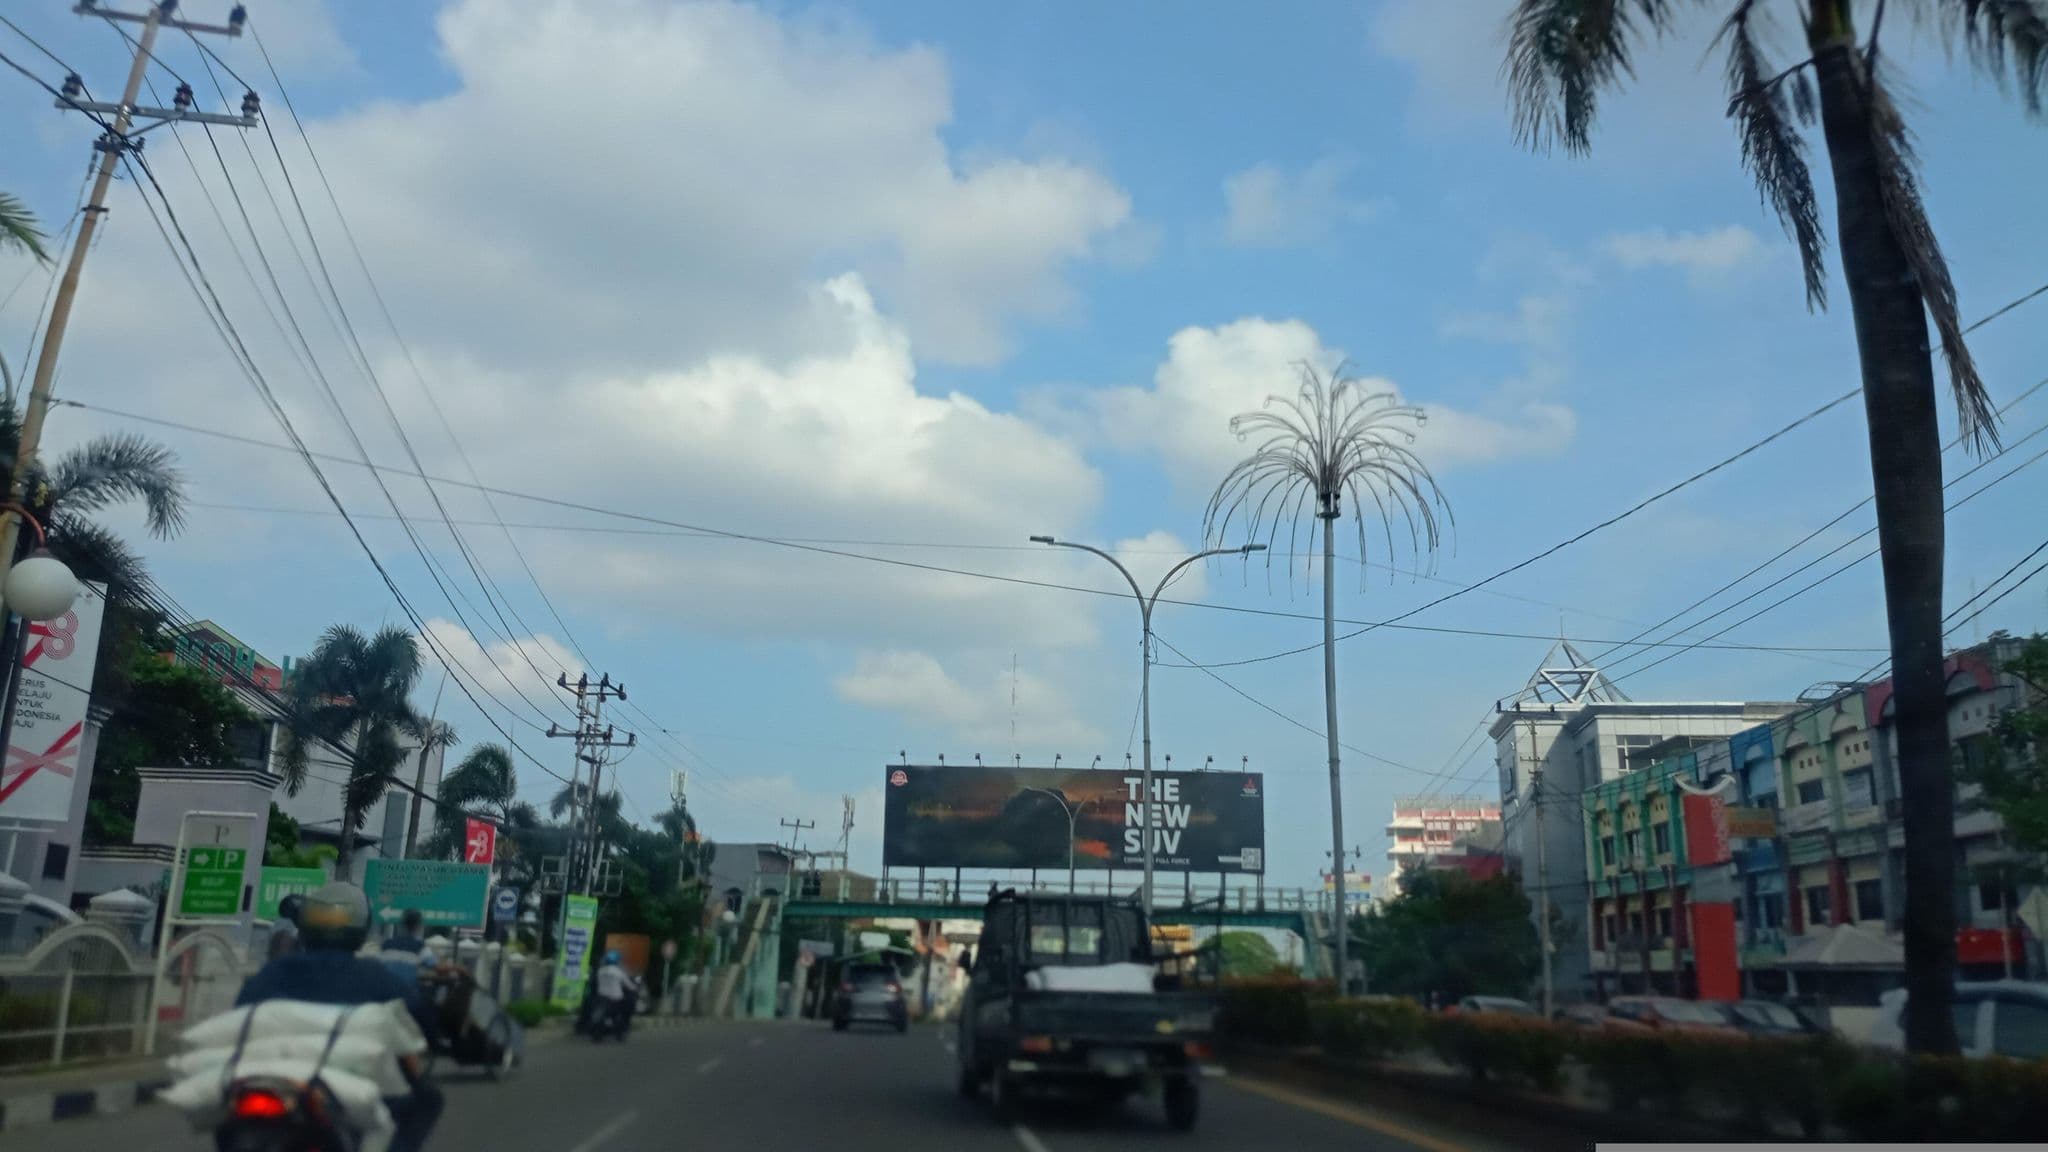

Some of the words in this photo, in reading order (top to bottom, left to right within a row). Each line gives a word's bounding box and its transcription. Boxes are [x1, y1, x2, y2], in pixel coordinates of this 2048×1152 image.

[17, 678, 46, 688] ERUS
[17, 688, 51, 699] ELAJU
[16, 698, 43, 709] NTUK
[1124, 777, 1180, 802] THE
[1124, 803, 1191, 828] NEW
[1124, 829, 1181, 854] SUV
[224, 851, 239, 868] P
